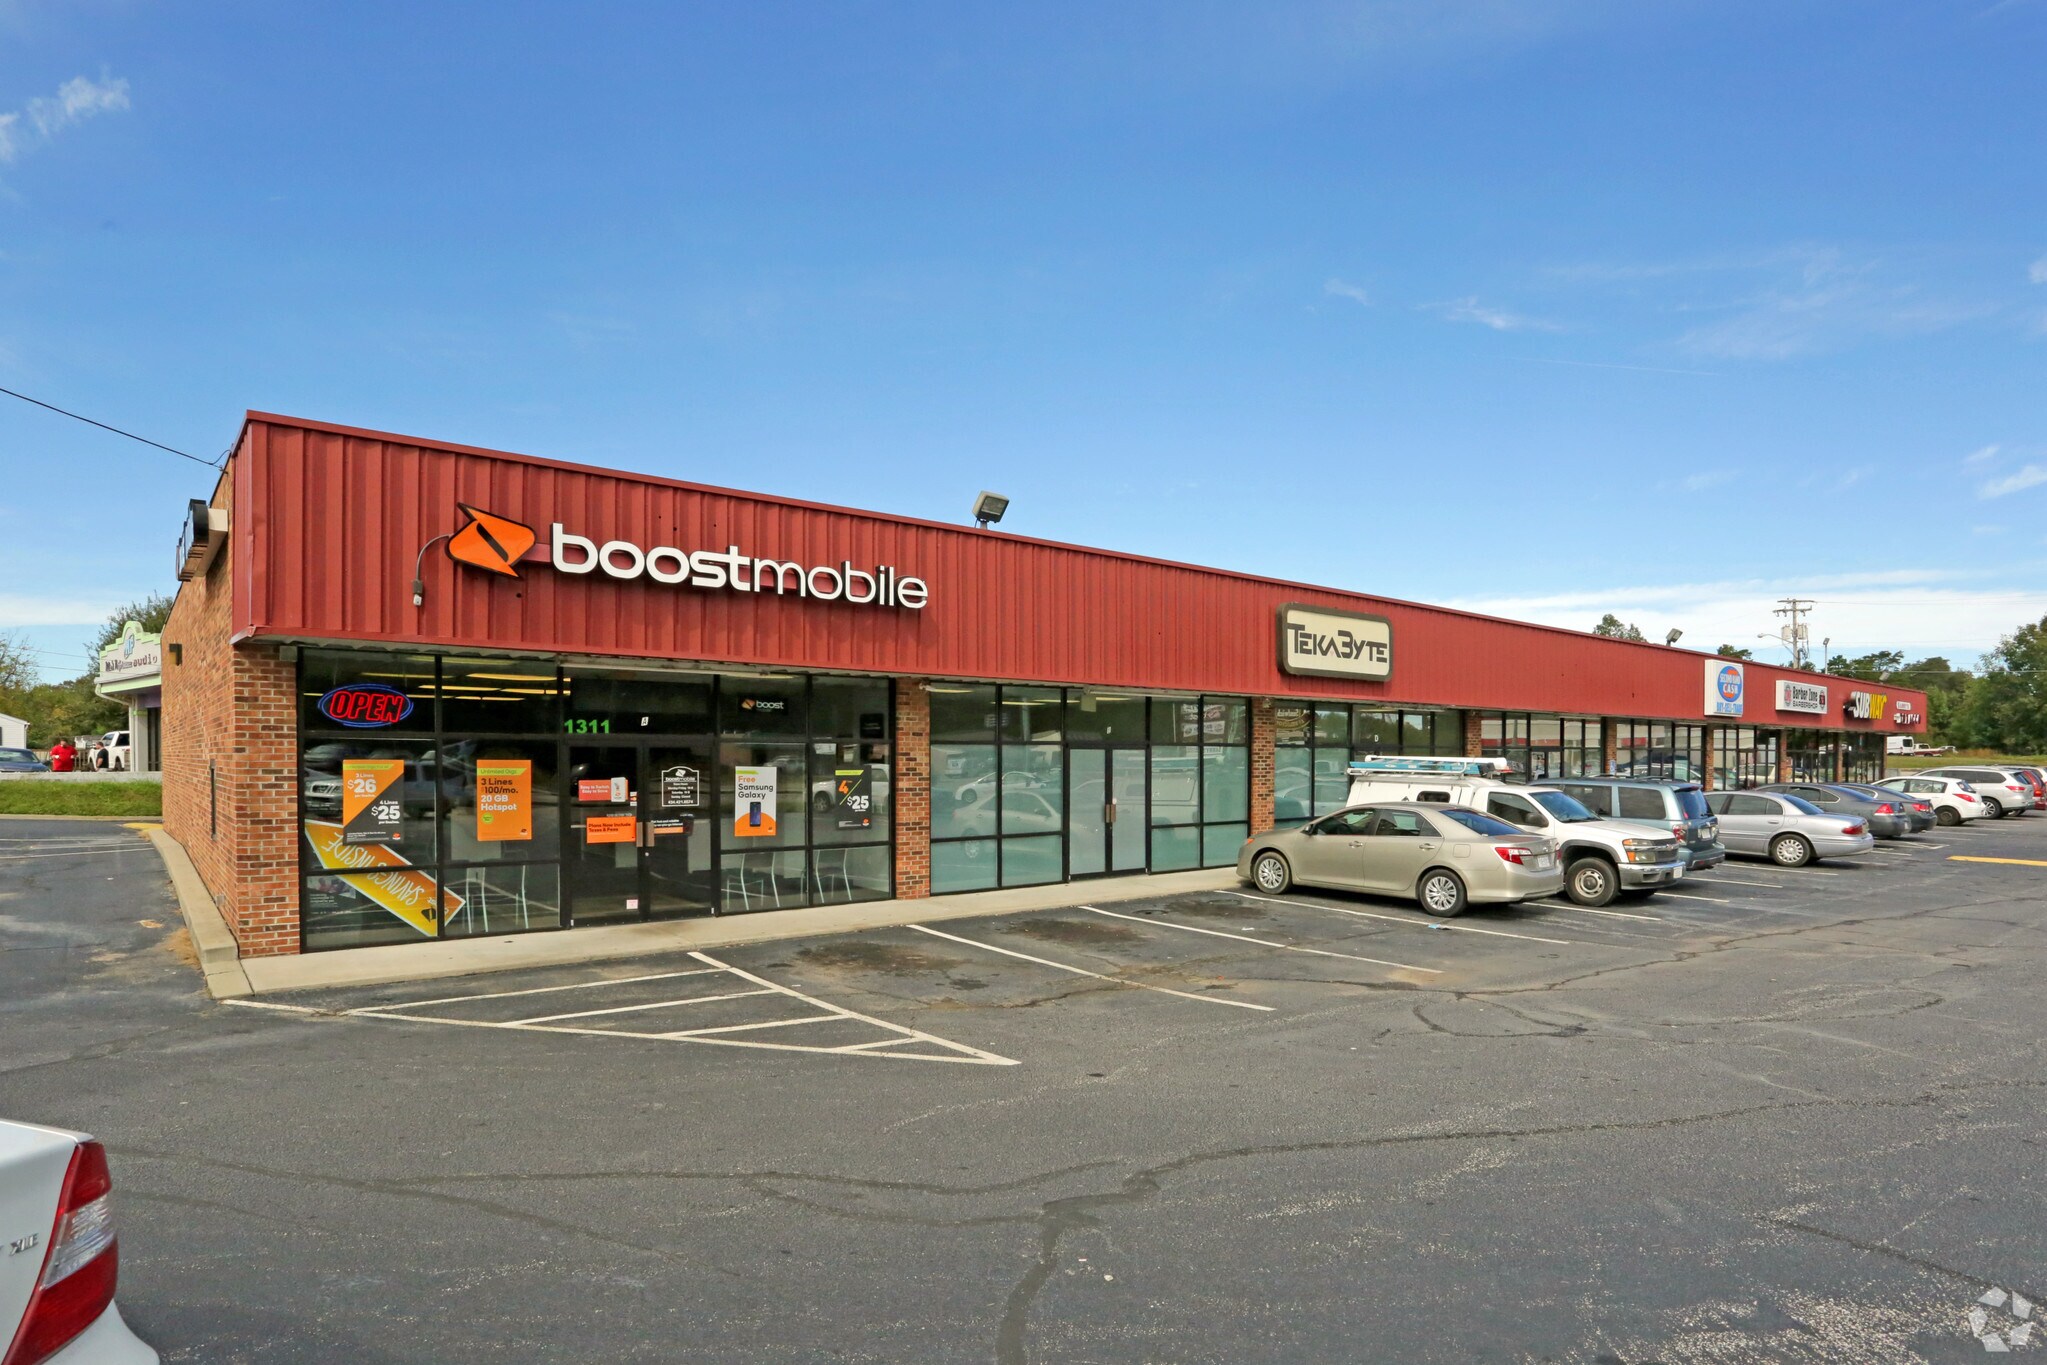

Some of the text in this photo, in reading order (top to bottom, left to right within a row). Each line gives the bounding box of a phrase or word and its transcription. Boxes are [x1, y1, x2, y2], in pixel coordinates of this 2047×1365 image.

[329, 691, 405, 723] OPEN
[756, 700, 784, 709] boost
[1851, 691, 1887, 719] SUBWAY
[564, 719, 610, 734] 1311
[347, 778, 377, 793] $26
[481, 778, 513, 786] 3 Lines
[738, 783, 774, 793] Samsung
[481, 794, 509, 803] 20 GB
[738, 791, 767, 800] Galaxy
[480, 803, 518, 813] Hotspot
[846, 795, 869, 810] $25
[371, 805, 401, 820] $25
